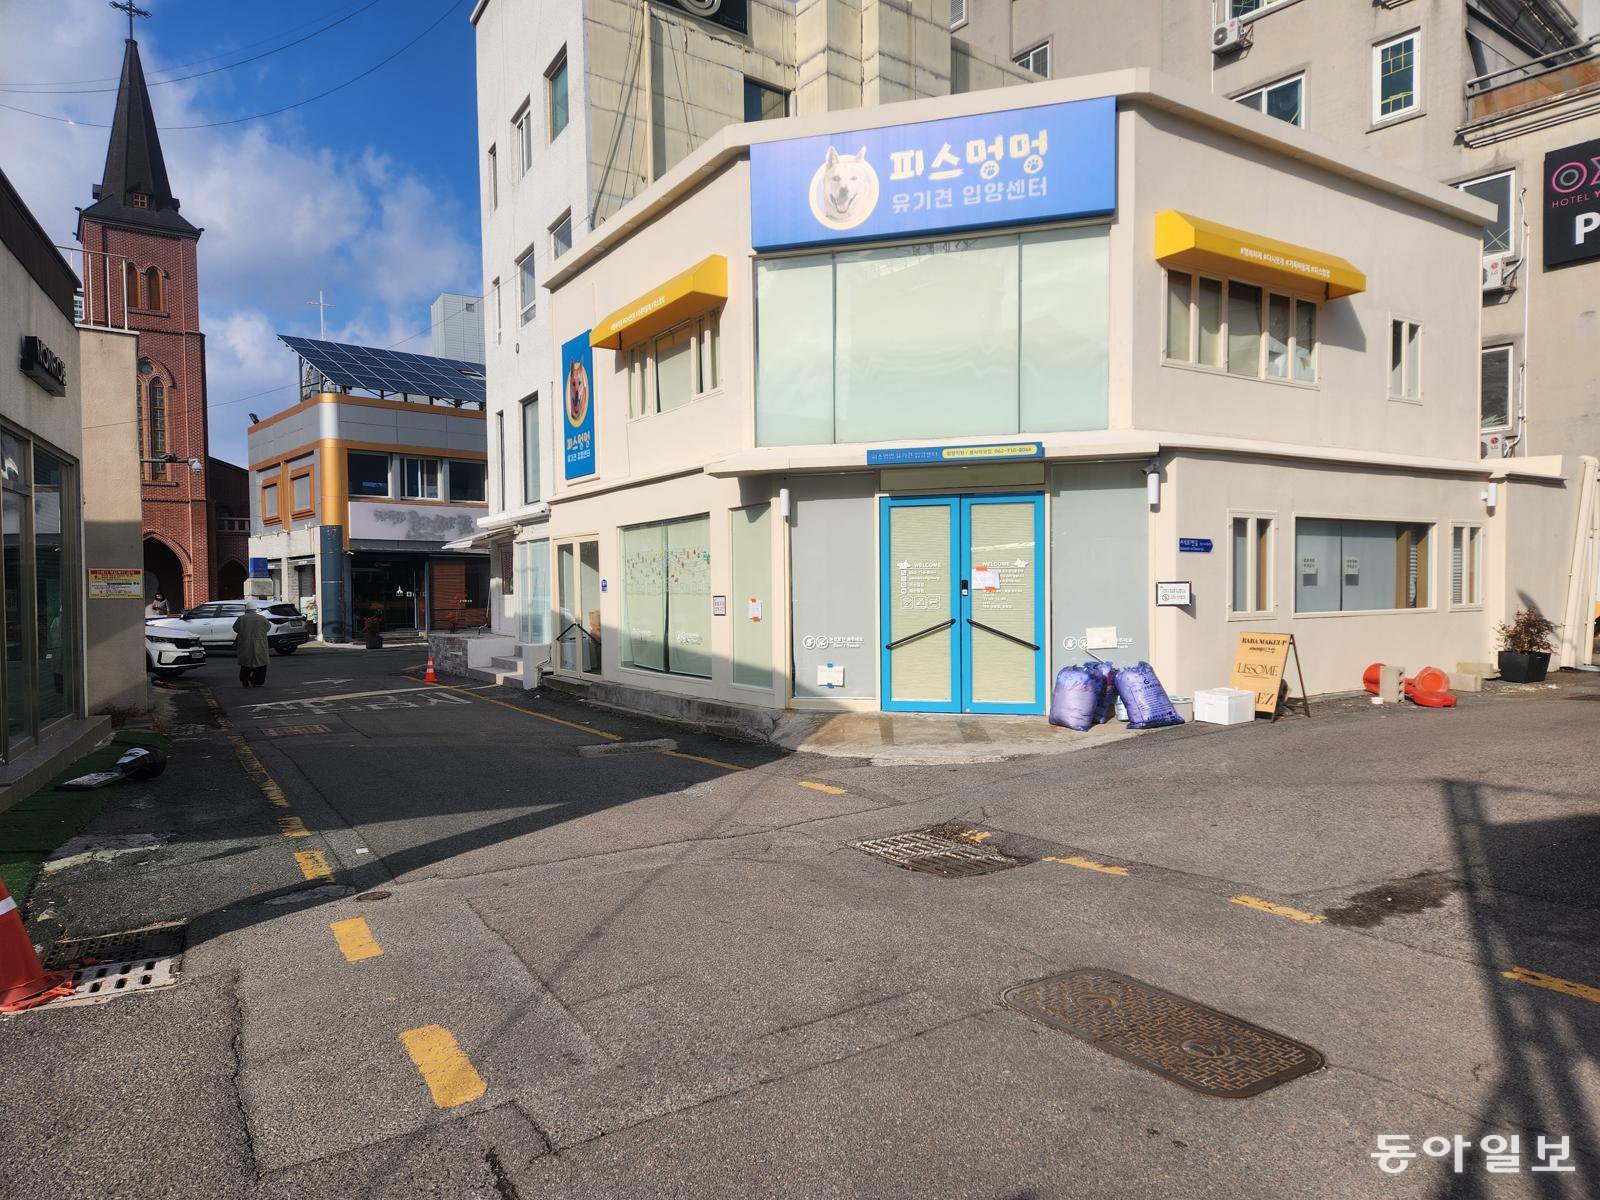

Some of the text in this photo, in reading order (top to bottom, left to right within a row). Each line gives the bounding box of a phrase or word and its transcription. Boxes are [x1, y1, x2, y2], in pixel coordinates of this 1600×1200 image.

[889, 129, 1048, 180] 피스멍멍
[892, 176, 1048, 214] 유기견 입양센터
[1552, 193, 1590, 208] HOTEL
[567, 430, 591, 451] 피스멍멍
[1237, 663, 1279, 677] LISSOME
